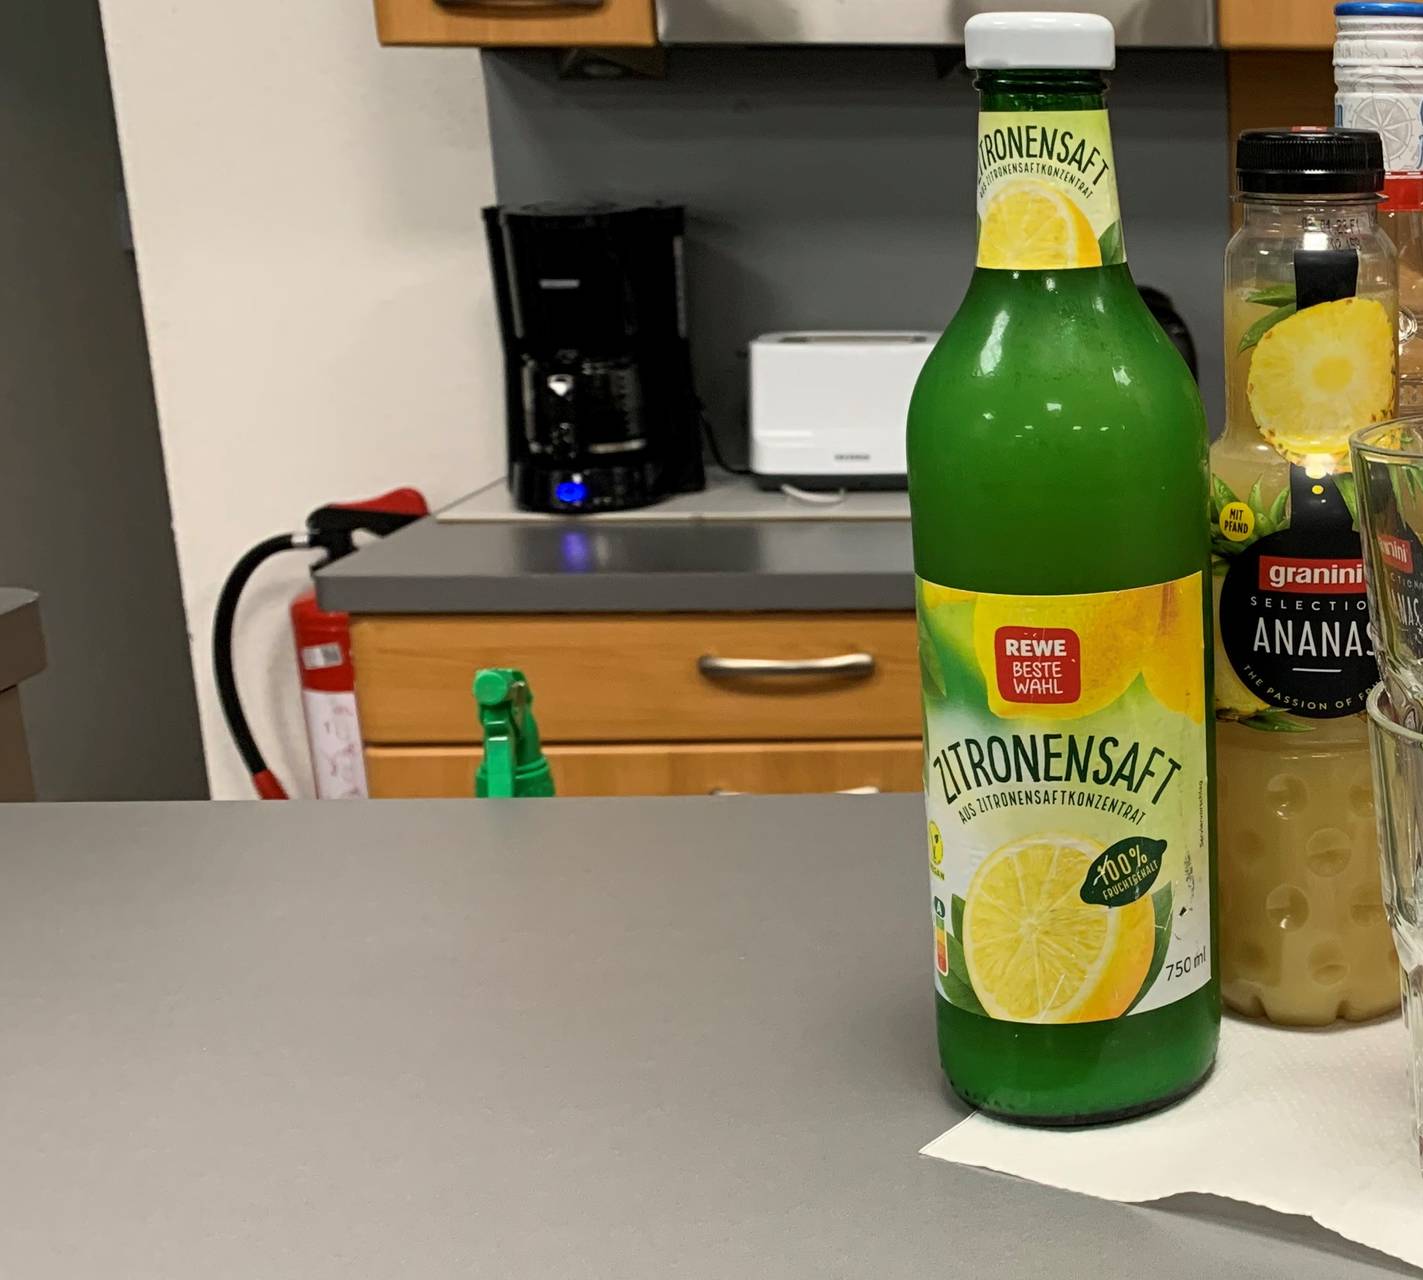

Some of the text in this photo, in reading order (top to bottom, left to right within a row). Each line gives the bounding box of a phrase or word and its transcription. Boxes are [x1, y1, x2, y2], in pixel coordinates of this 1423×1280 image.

[978, 125, 1110, 186] TRONENSAFT
[986, 162, 1094, 199] ZITRONENSAFTKONZENTRAT
[1224, 520, 1249, 534] PFAND
[1229, 508, 1245, 521] MIT
[1269, 563, 1364, 588] granini
[1250, 596, 1367, 612] SELECTIO
[1005, 638, 1067, 657] REWE
[1013, 661, 1063, 678] BESTE
[1013, 678, 1063, 695] WAHL
[1243, 663, 1264, 688] THE
[1267, 686, 1328, 711] PASSION
[1335, 696, 1352, 710] OF
[932, 733, 1182, 806] ZITRONENSAFT
[958, 789, 1147, 826] AUS ZITRONENSAFTKONZENTRAT
[1096, 844, 1148, 886] 100%
[1102, 859, 1159, 901] FRUCHTGEHALT
[1166, 945, 1207, 982] 750 ml
